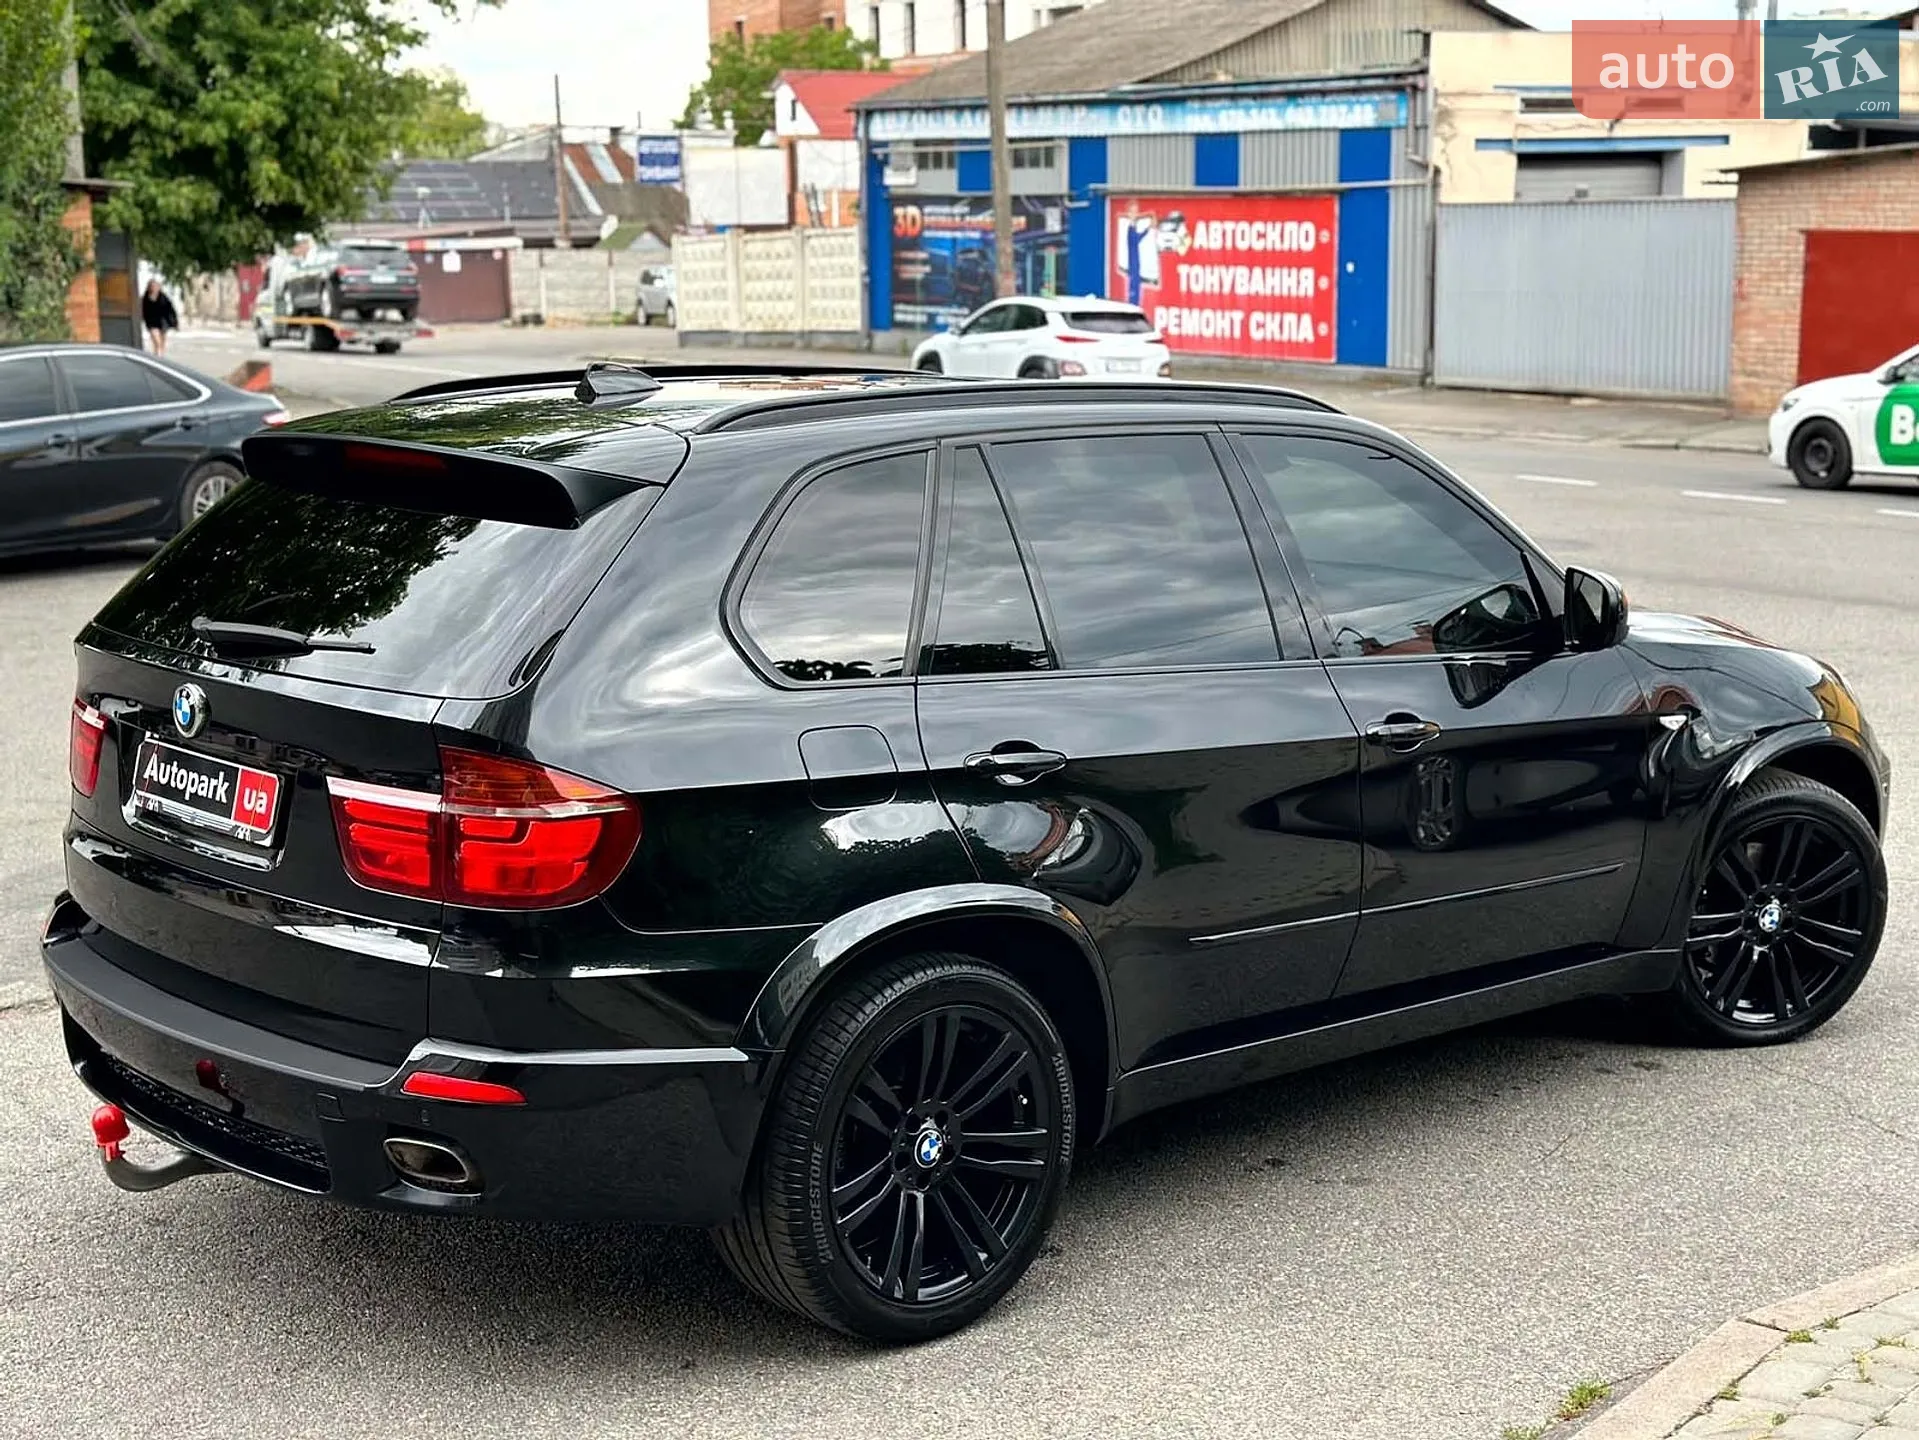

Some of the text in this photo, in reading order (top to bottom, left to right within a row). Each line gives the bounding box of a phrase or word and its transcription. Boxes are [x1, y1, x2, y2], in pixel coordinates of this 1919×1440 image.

[893, 206, 923, 238] 3D
[1193, 220, 1316, 252] АВТОСКЛО
[1177, 264, 1315, 298] ТОНУВАННЯ
[1154, 306, 1315, 343] РЕМОНТ СКЛА
[143, 753, 268, 815] Autopark ua
